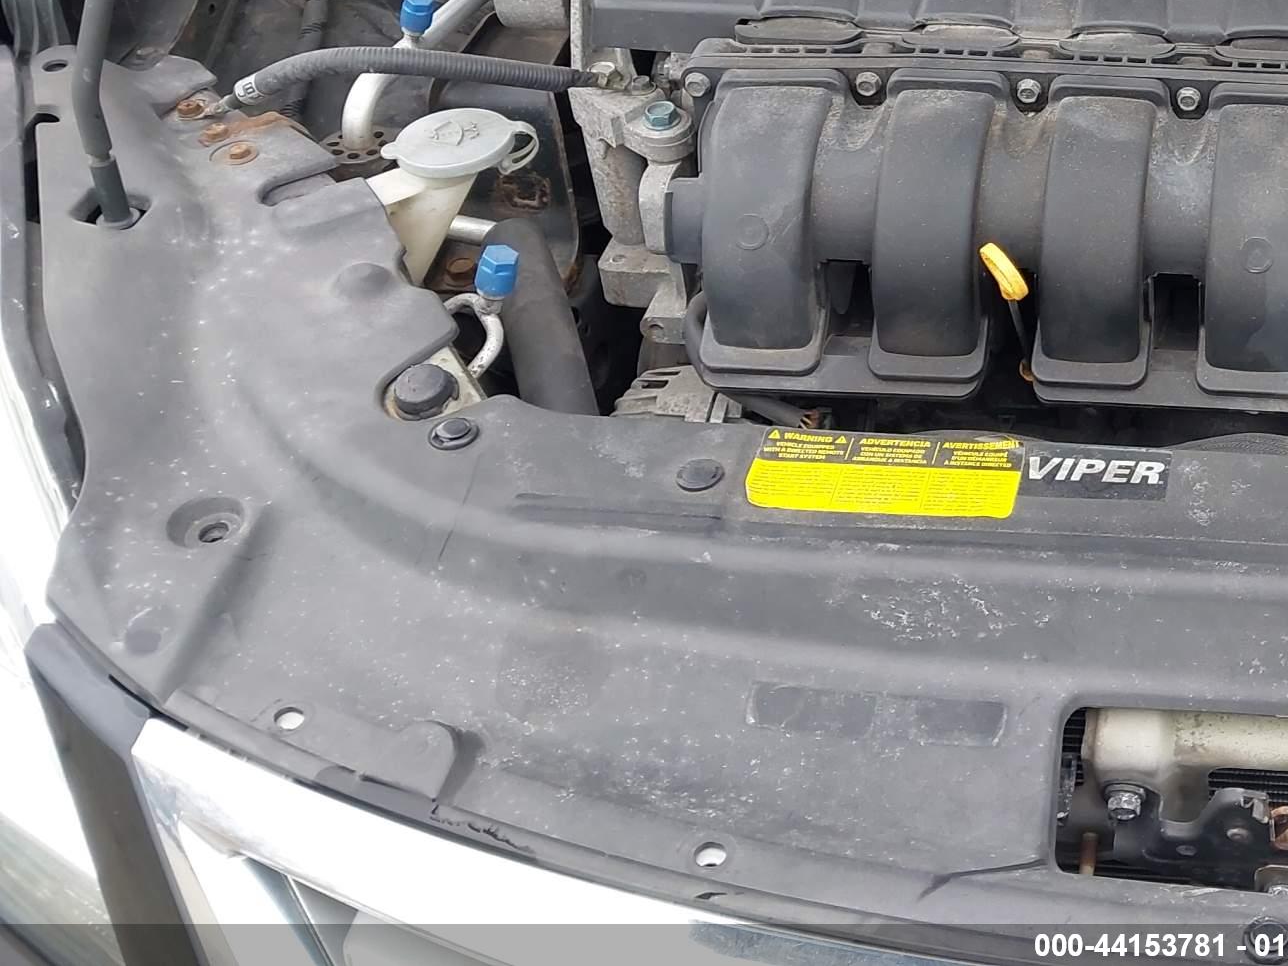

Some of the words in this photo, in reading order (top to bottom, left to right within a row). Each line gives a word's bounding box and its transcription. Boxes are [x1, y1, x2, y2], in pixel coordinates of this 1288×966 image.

[783, 432, 833, 443] WARNING
[858, 438, 931, 448] ADVERTENCIA
[941, 440, 1020, 450] AVERTISSEMENT
[1028, 456, 1166, 485] VIPER
